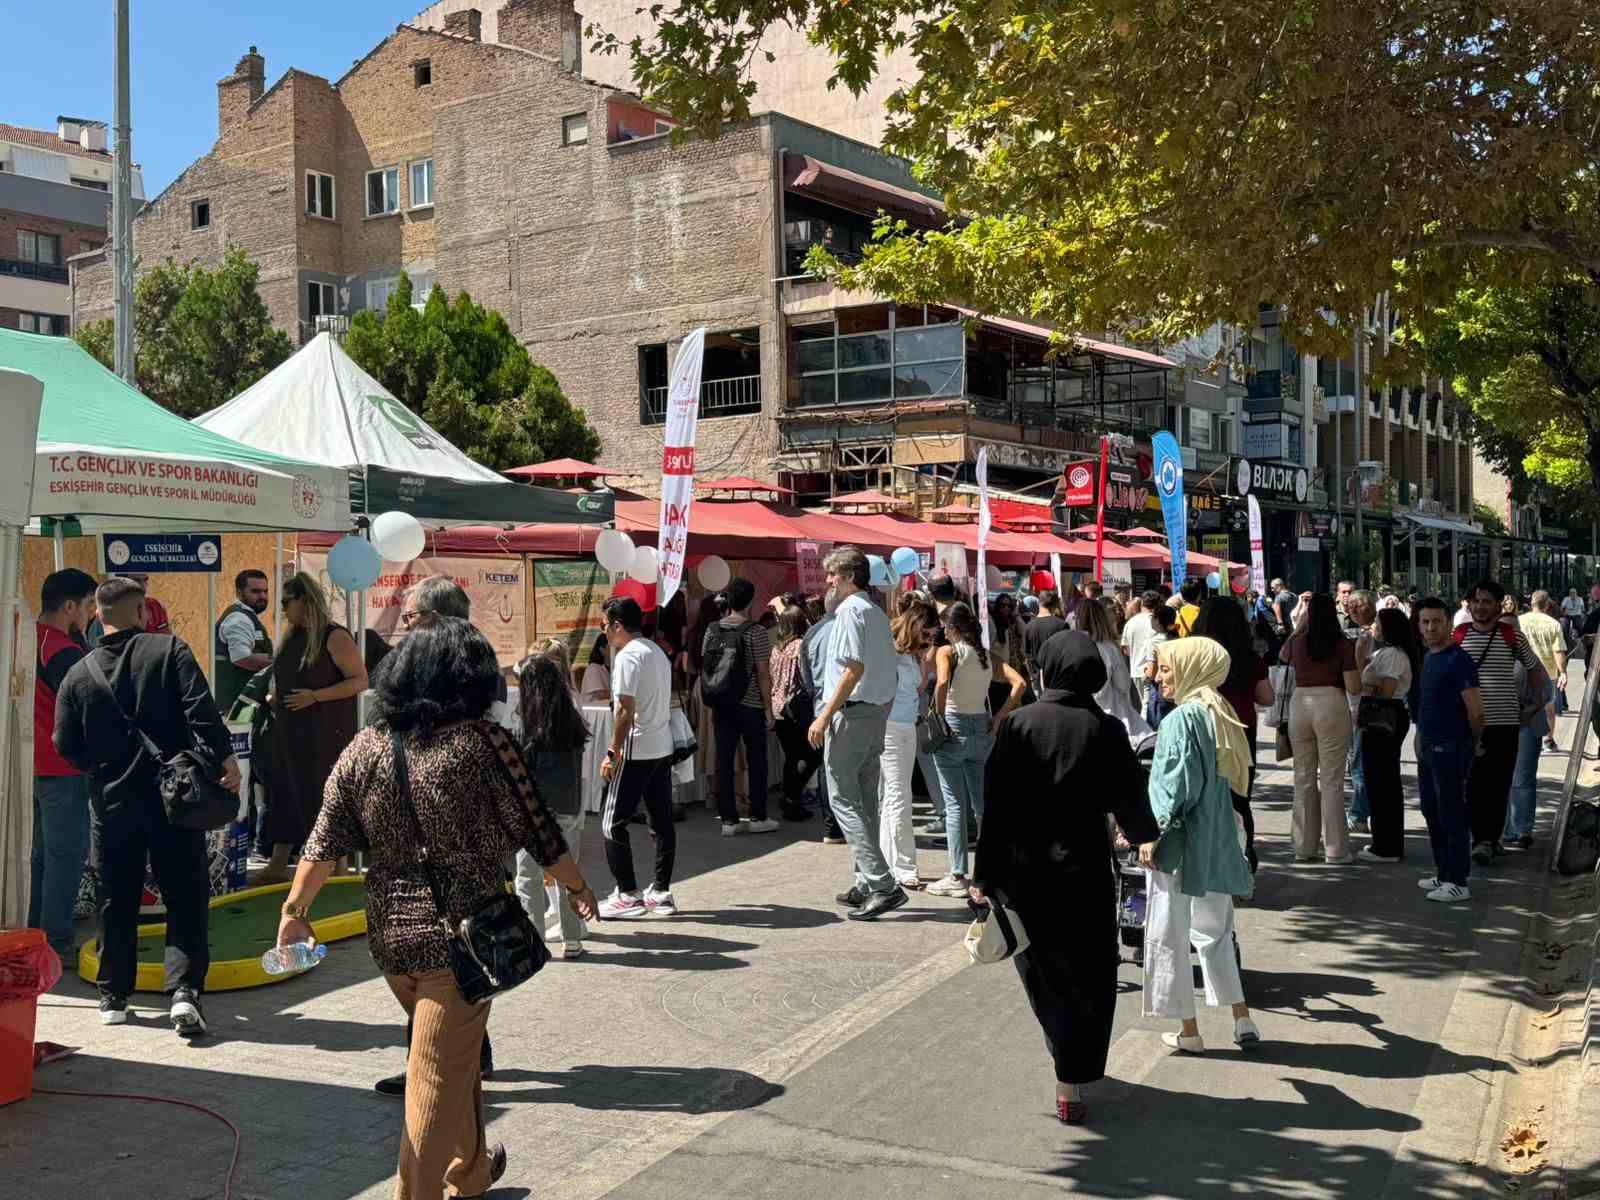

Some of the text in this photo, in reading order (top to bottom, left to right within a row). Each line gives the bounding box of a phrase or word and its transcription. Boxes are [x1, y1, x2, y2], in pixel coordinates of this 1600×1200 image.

[49, 456, 258, 489] T.C. GENÇLİK VE SPOR BAKANLIĞI
[50, 479, 104, 495] ESKİŞEHİR
[106, 482, 149, 498] GENÇLİK
[150, 485, 162, 497] VE
[164, 487, 189, 500] SPOR
[201, 488, 257, 506] MÜDÜRLÜĞÜ
[486, 573, 519, 584] KETEM
